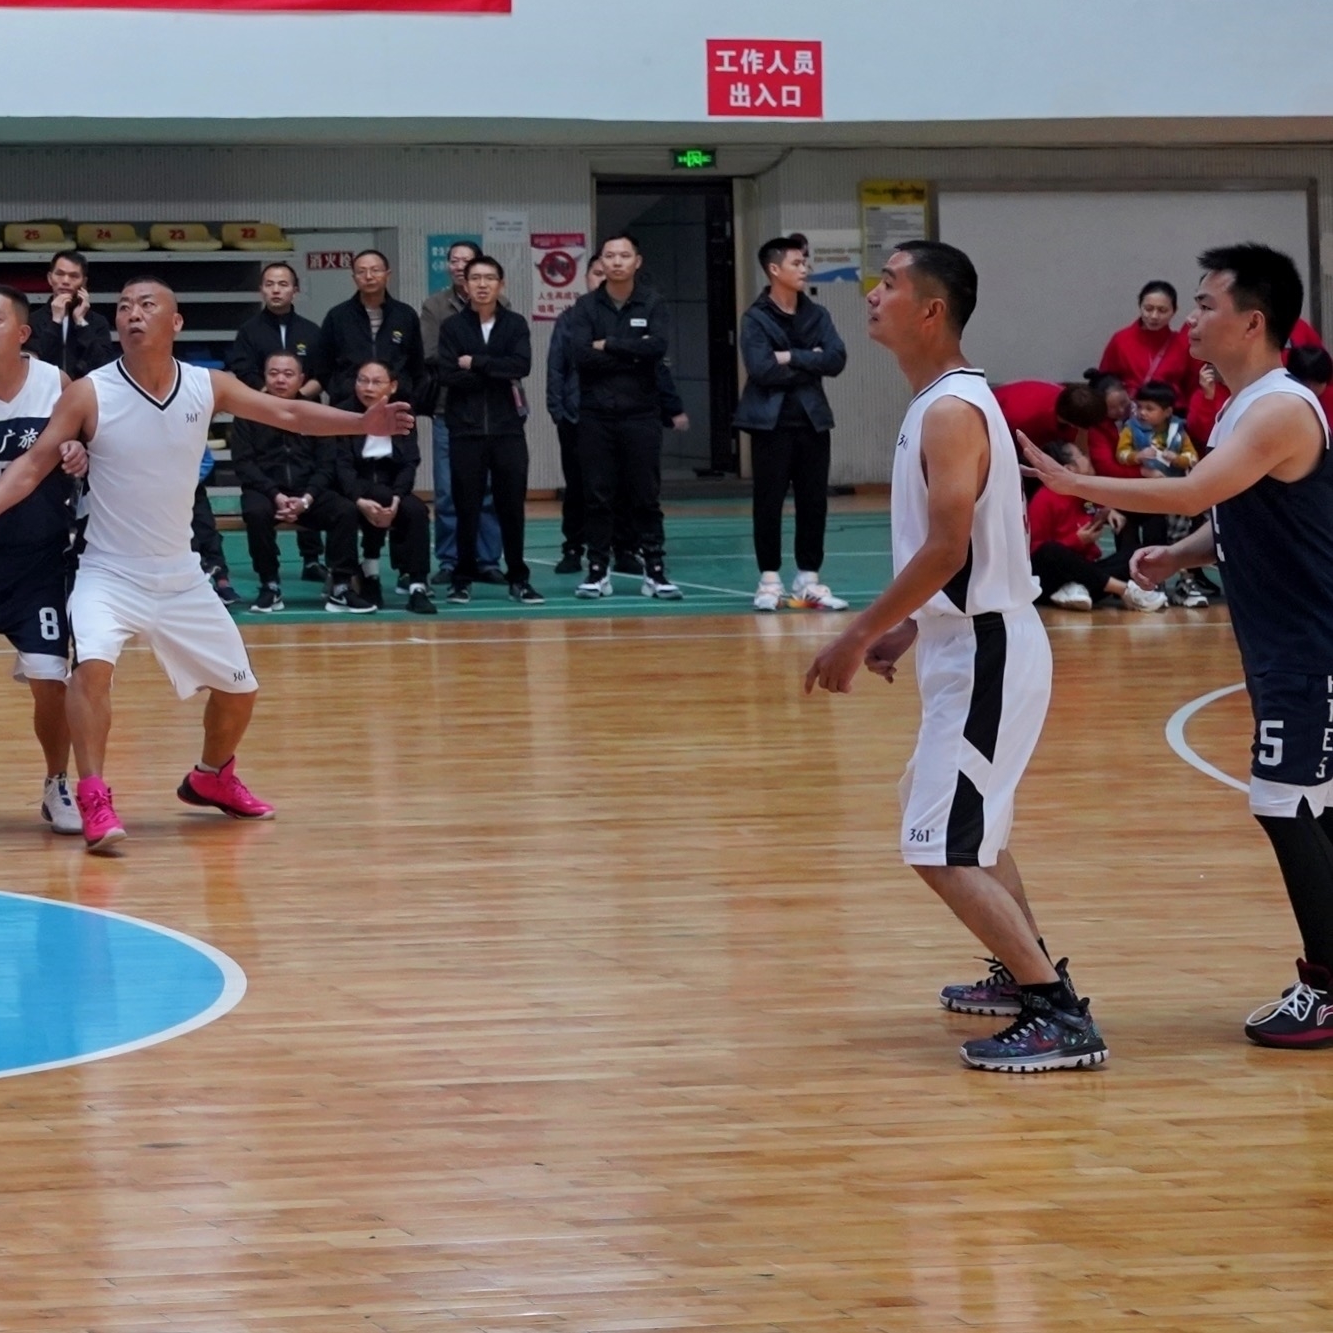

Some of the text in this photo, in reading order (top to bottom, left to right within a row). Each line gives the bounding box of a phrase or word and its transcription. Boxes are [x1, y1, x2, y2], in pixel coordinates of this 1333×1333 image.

[714, 49, 815, 75] 工作人员
[729, 83, 802, 107] 出入口
[97, 229, 112, 239] 24
[169, 229, 186, 241] 23
[241, 228, 257, 239] 22
[38, 606, 61, 641] 8
[1257, 719, 1284, 767] 5
